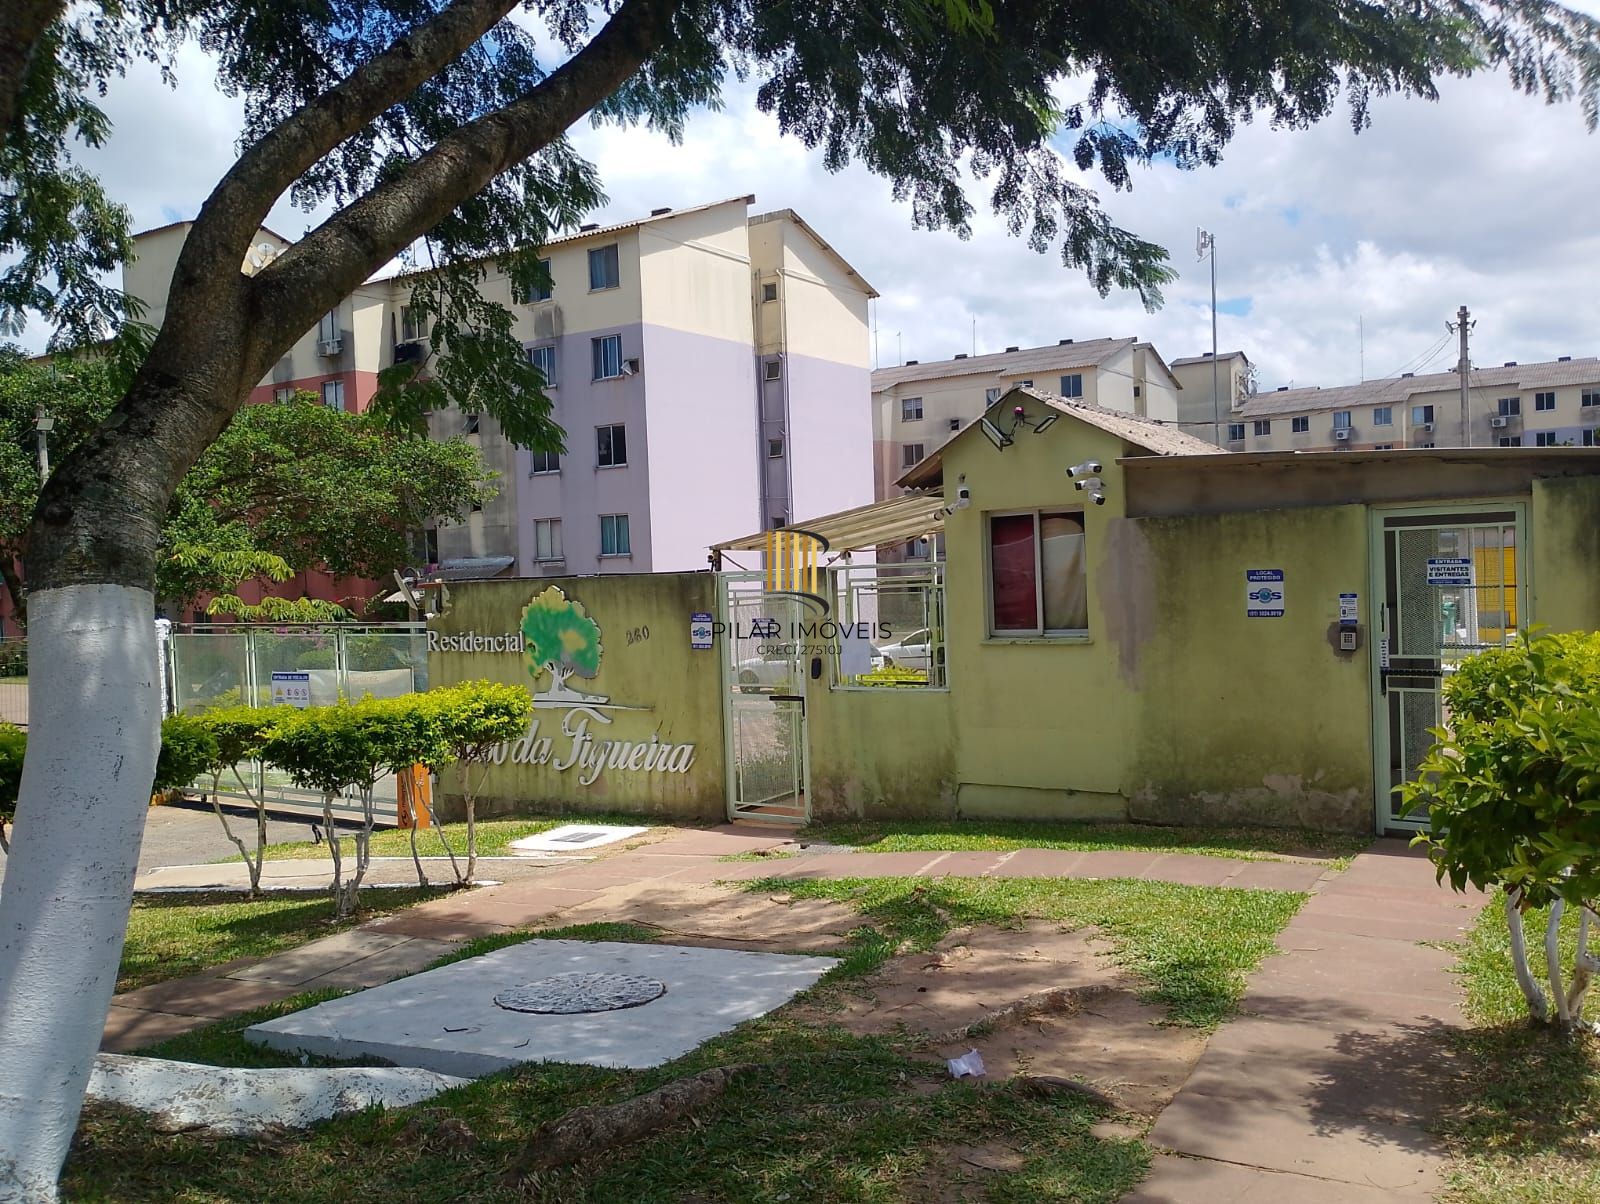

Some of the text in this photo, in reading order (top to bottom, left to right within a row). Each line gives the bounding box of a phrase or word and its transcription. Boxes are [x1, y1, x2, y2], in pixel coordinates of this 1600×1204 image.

[426, 630, 525, 653] Residencial
[626, 624, 650, 647] 260
[512, 719, 553, 764] da
[552, 707, 697, 786] Figueira
